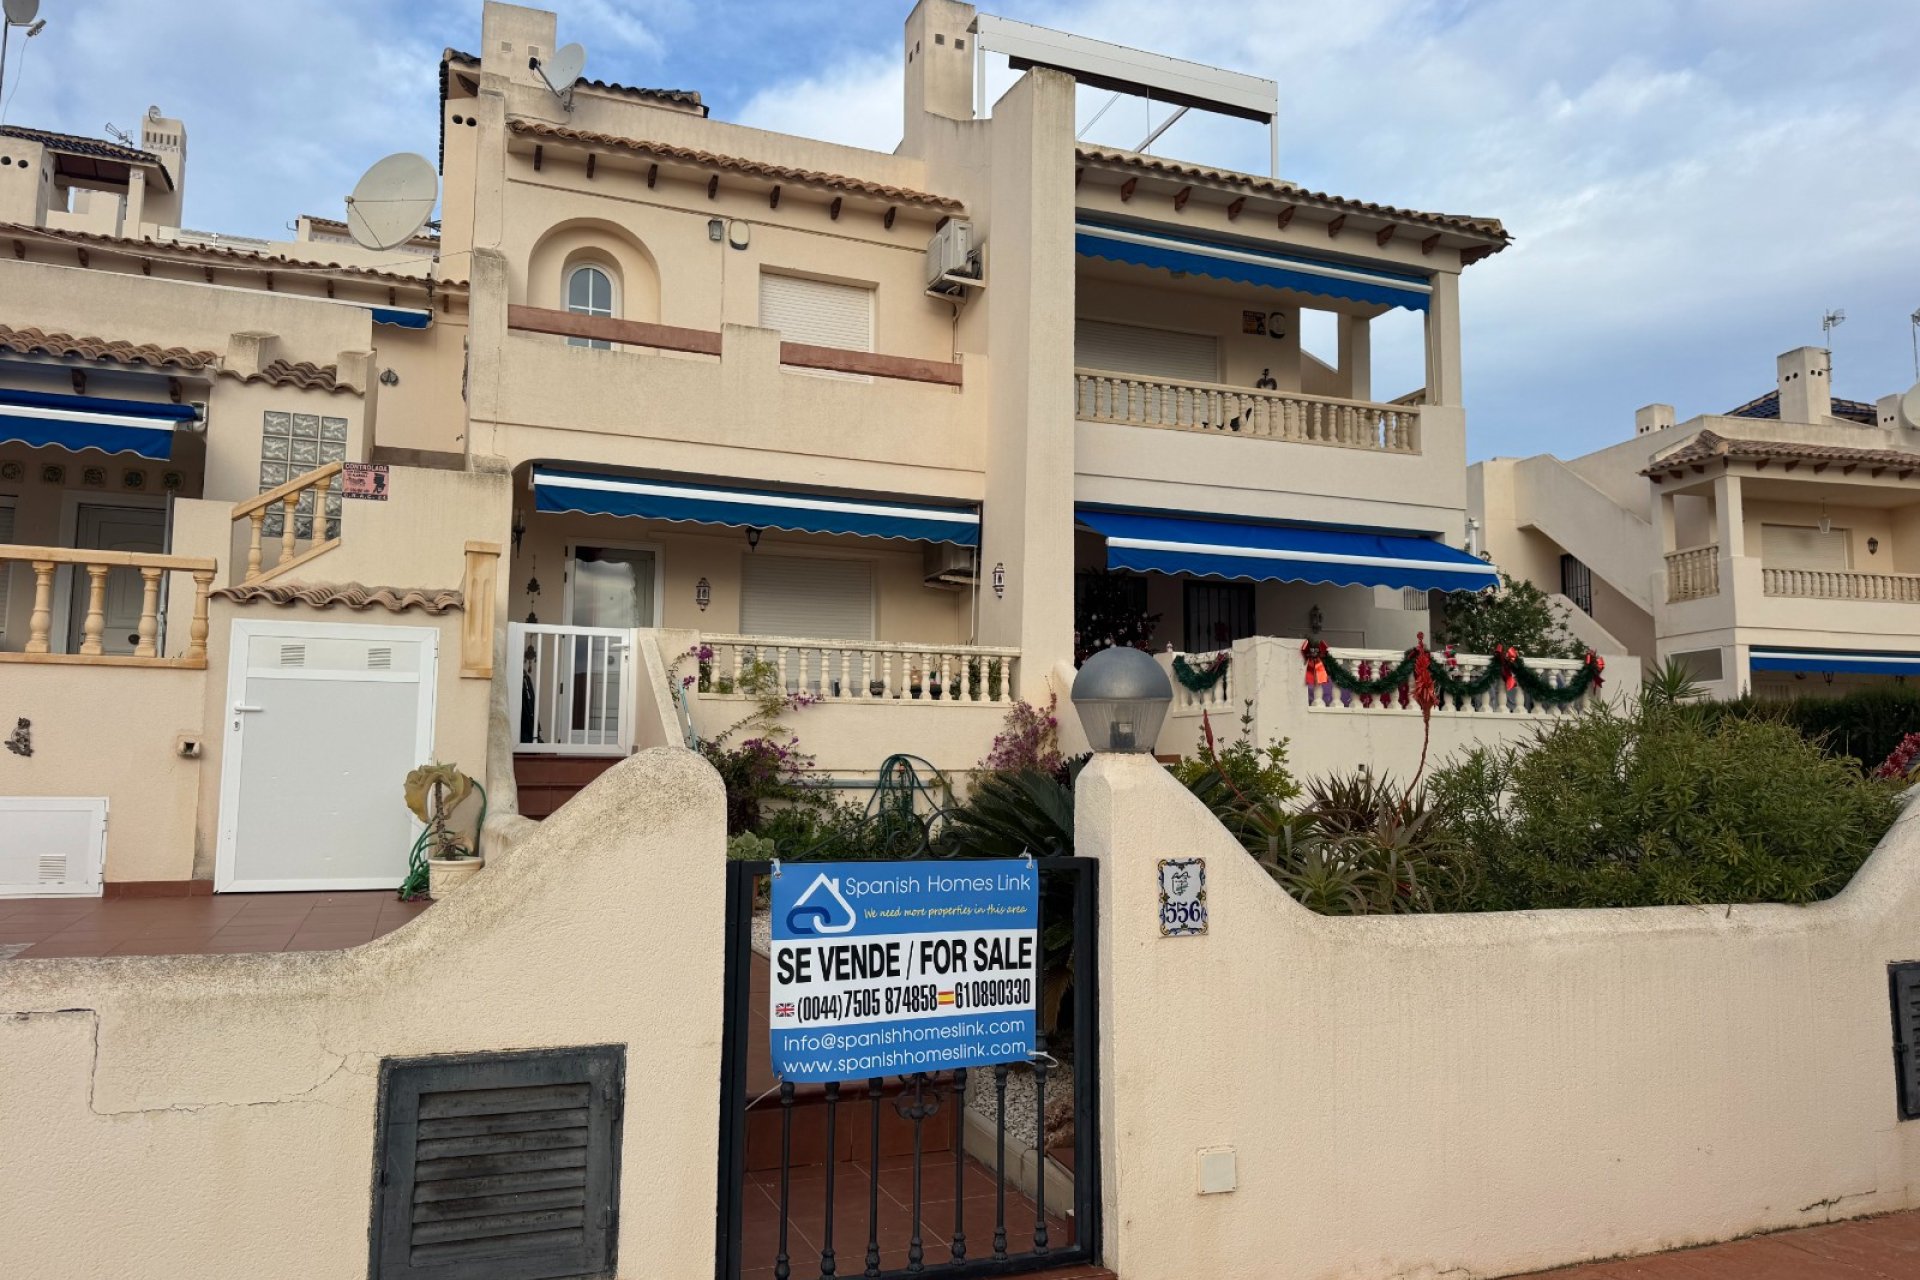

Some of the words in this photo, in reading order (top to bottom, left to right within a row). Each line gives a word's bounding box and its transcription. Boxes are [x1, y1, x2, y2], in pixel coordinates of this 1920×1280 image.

[845, 876, 920, 898] Spanish
[928, 875, 993, 892] Homes
[997, 874, 1031, 891] Link
[864, 907, 878, 919] We
[880, 906, 901, 917] need
[904, 909, 926, 917] more
[928, 904, 972, 919] properties
[974, 904, 985, 914] in
[986, 903, 1006, 914] this
[1007, 905, 1028, 914] area
[1165, 900, 1201, 923] 556
[777, 947, 812, 985] SE
[818, 942, 901, 982] VENDE
[906, 940, 914, 980] /
[920, 939, 968, 975] FOR
[973, 937, 1033, 972] SALE
[885, 983, 938, 1013] 874858
[955, 978, 1031, 1009] 610890330
[784, 1019, 1026, 1052] info@spanishhomeslink.com
[783, 1041, 1027, 1074] www.spanishhomeslink.com
